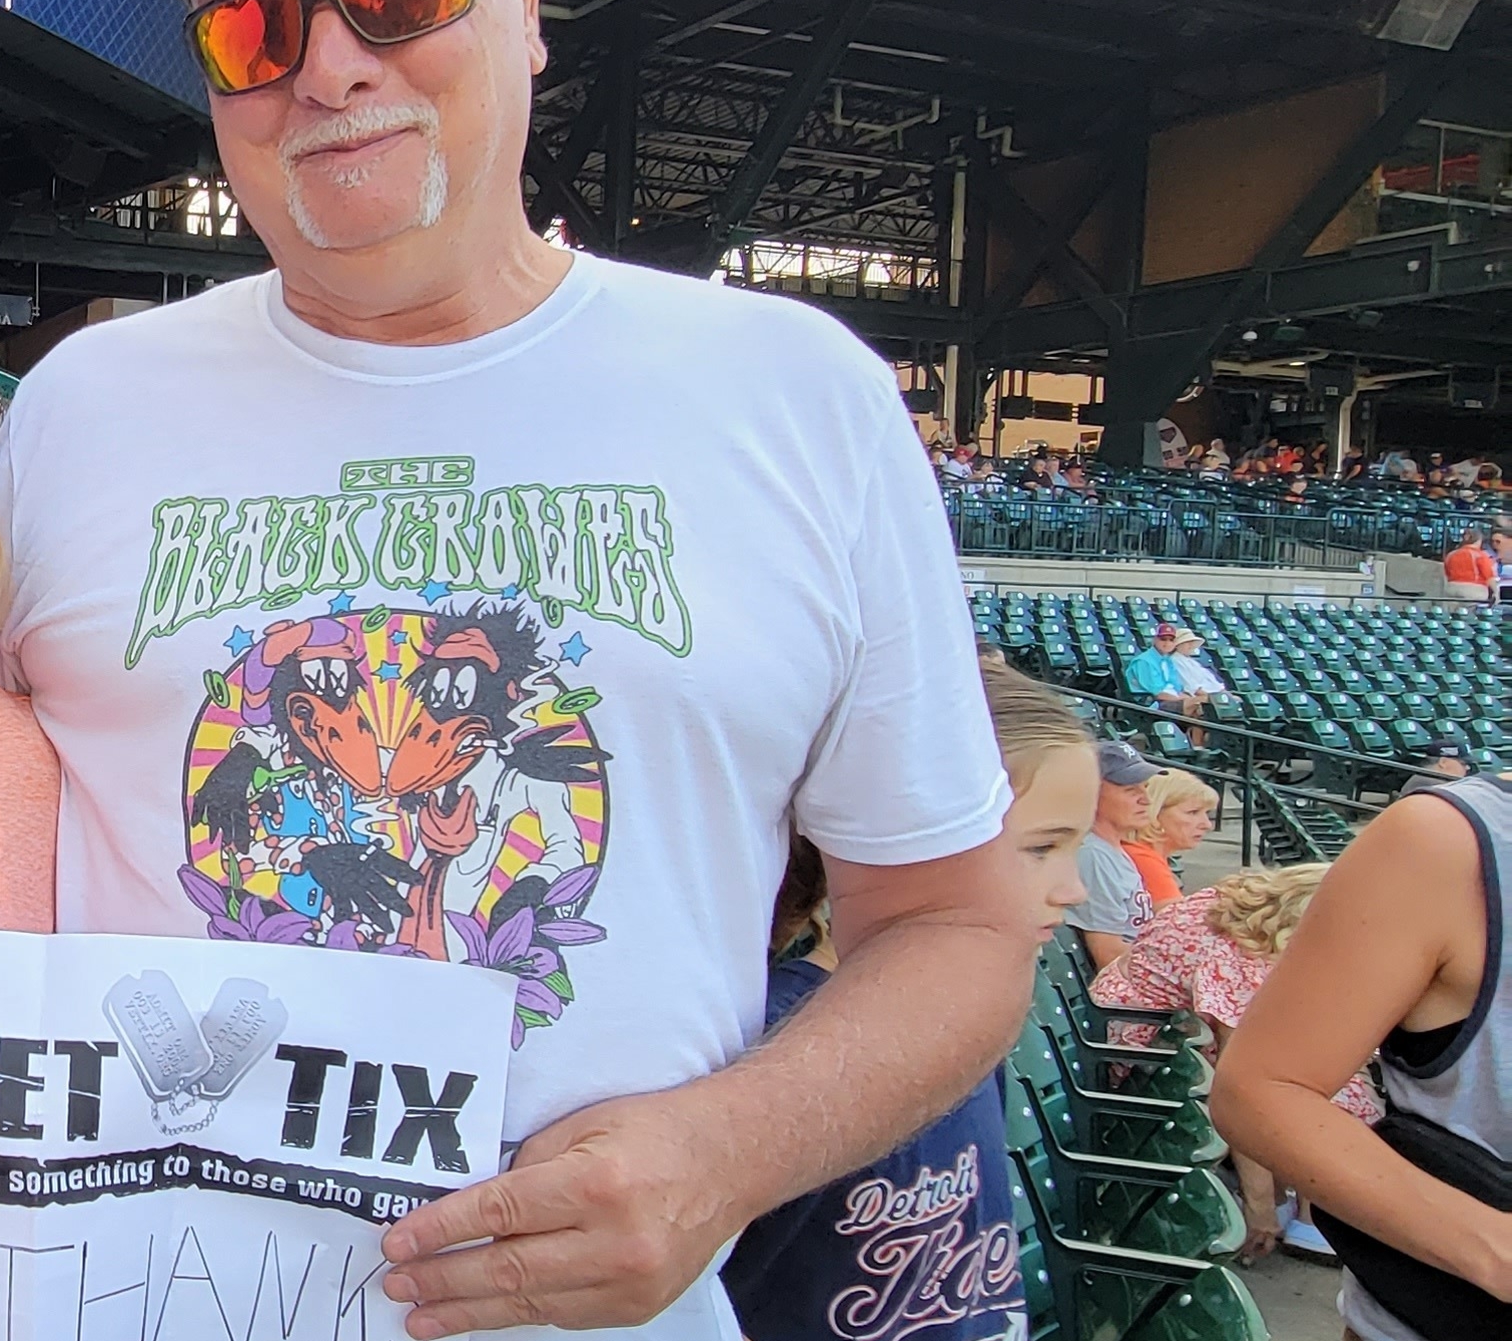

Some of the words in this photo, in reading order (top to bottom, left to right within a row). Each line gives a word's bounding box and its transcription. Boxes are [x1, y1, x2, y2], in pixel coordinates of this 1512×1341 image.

[344, 459, 472, 490] THE
[128, 493, 373, 667] BLACK
[383, 485, 691, 658] CROWES
[274, 1043, 479, 1175] TIX
[8, 1158, 156, 1195] something
[162, 1154, 190, 1177] to
[201, 1158, 287, 1193] those
[297, 1178, 362, 1207] who
[835, 1144, 979, 1235] Detroit
